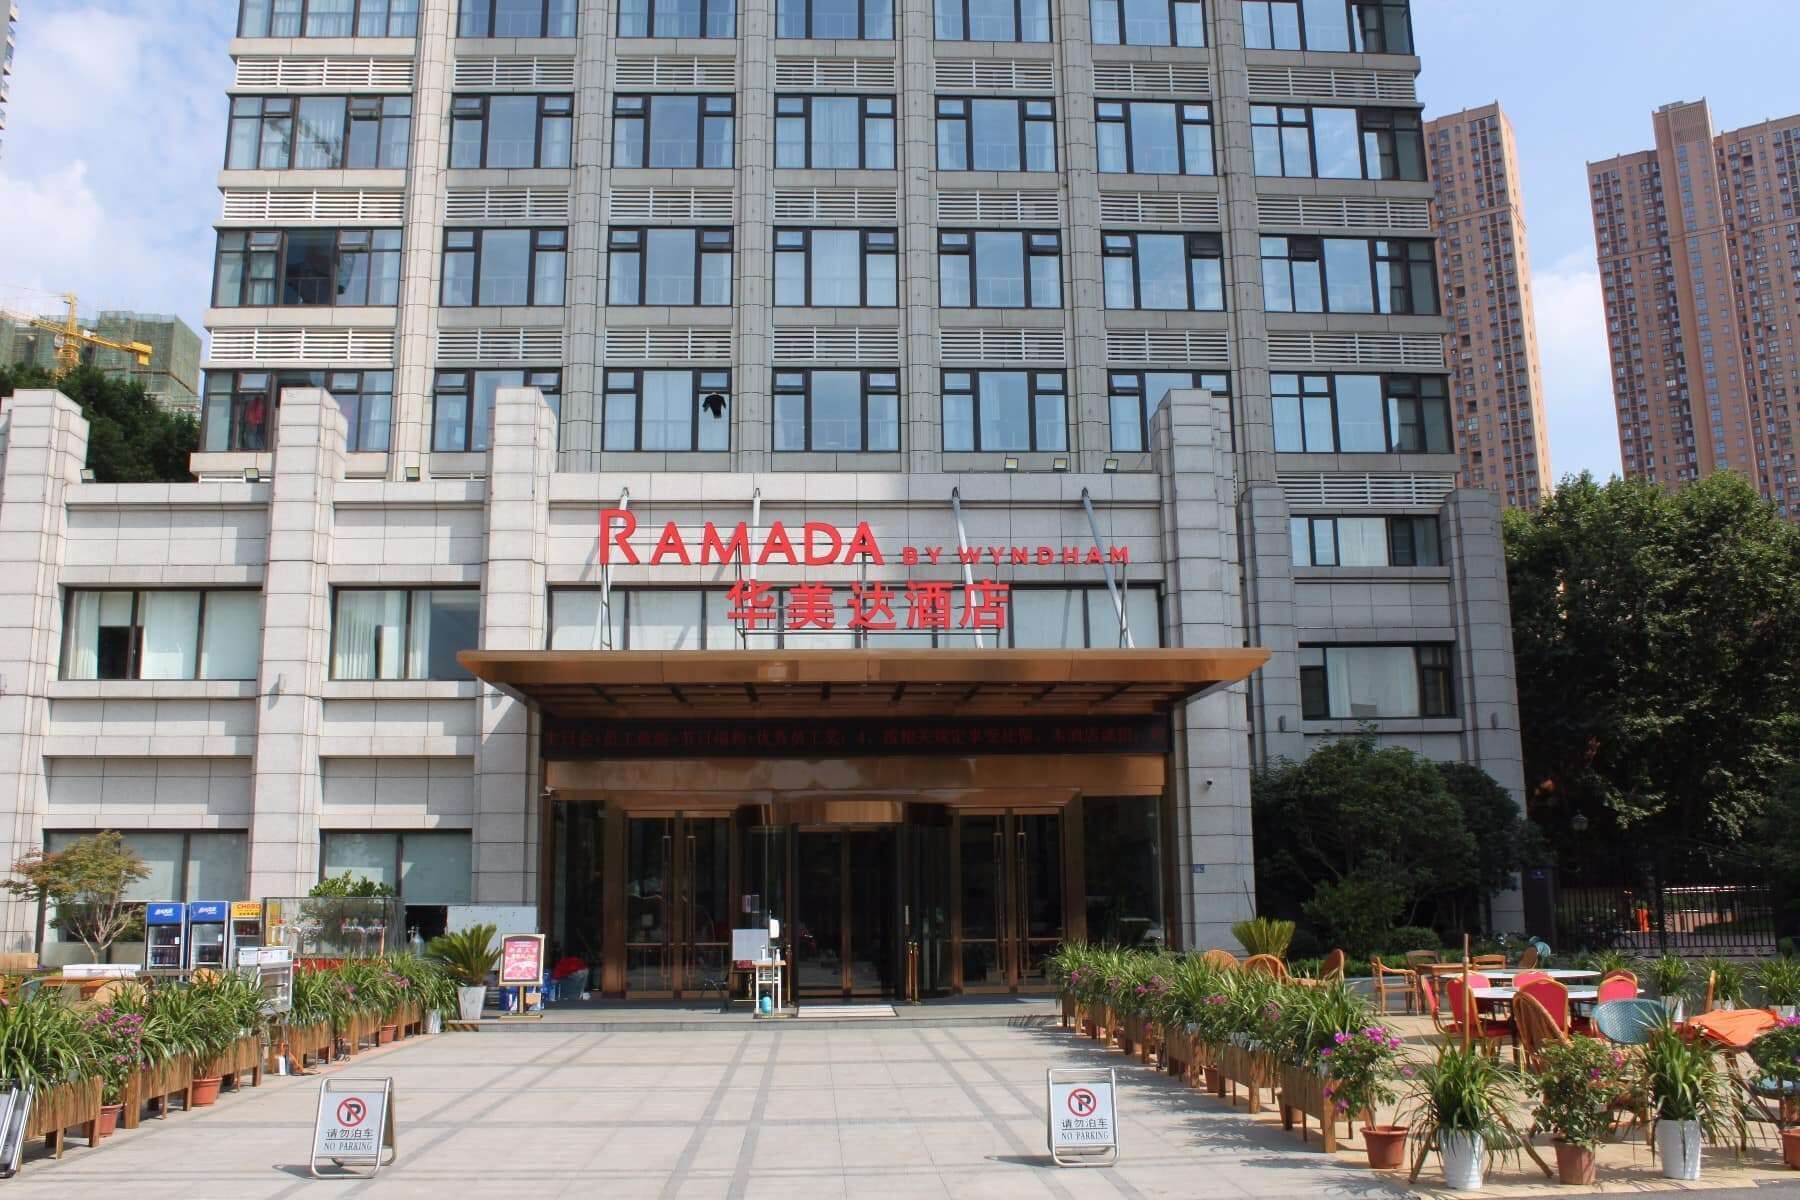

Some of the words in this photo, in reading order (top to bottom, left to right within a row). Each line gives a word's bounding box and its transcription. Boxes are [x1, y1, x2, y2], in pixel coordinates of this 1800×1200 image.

[599, 508, 885, 566] RAMADA
[902, 546, 943, 566] BY
[957, 545, 1131, 565] WYNDHAM
[727, 578, 1010, 630] 华美达酒店
[1062, 1119, 1108, 1128] 请勿泊车
[327, 1129, 373, 1138] 请勿泊车
[1062, 1132, 1073, 1140] NO
[1077, 1131, 1109, 1140] PARKING
[324, 1142, 335, 1151] NO
[339, 1142, 372, 1151] PARKING
